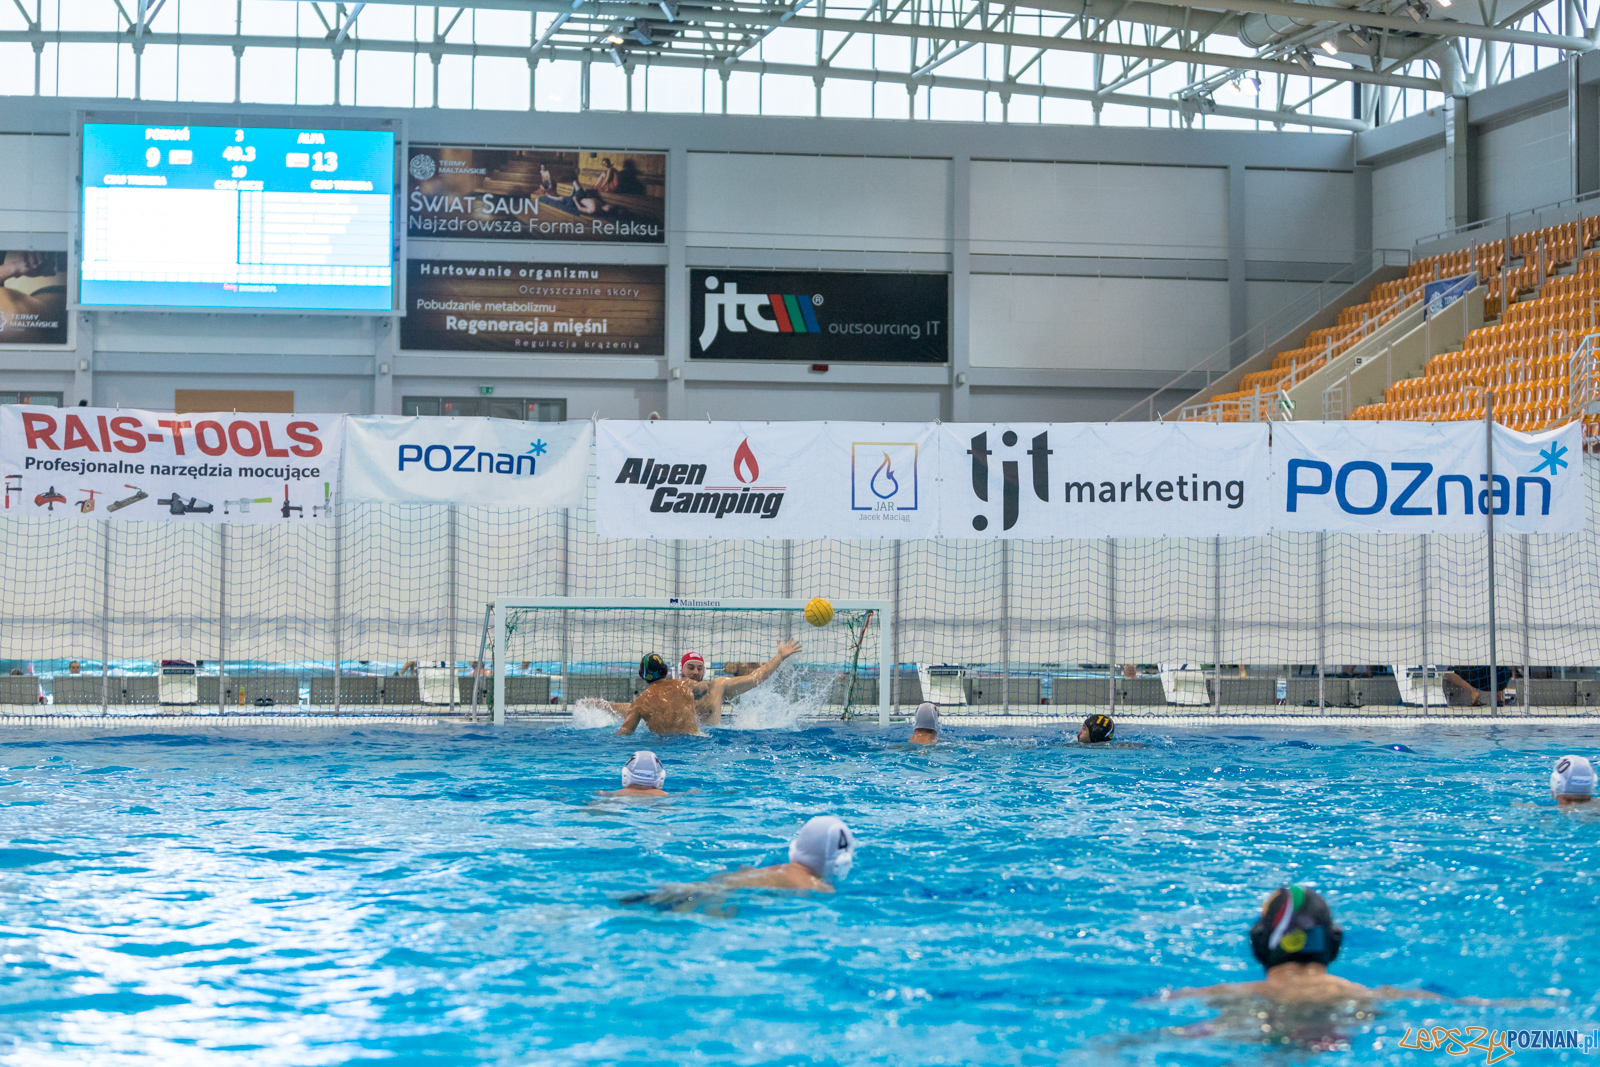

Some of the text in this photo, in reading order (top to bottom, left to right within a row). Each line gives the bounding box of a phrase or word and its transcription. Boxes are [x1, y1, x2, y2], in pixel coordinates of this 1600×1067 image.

[235, 129, 244, 142] 3
[297, 133, 325, 144] ALFA
[146, 146, 160, 168] 9
[312, 152, 338, 172] 13
[438, 166, 487, 174] MALTAŃSKIE
[409, 215, 658, 236] Najzdrowsza Forma Relaksu
[420, 264, 599, 280] Hartowanie organizmu
[519, 285, 640, 298] Oczyszczanie skóry
[416, 299, 556, 313] Pobudzanie metabolizmu
[446, 316, 608, 336] Regeneracja mięśni
[828, 320, 941, 340] outsourcing IT
[514, 338, 640, 350] Regulacja krążenia
[22, 412, 324, 458] RAIS-TOOLS
[25, 456, 320, 481] Profesjonalne narzędzia mocujące
[614, 458, 708, 490] Alpen
[1064, 473, 1244, 510] marketing
[650, 486, 785, 519] Camping
[874, 502, 894, 512] JAR
[882, 514, 910, 522] Maciąg
[680, 599, 720, 607] Malmsten
[1096, 715, 1110, 728] 11
[838, 828, 849, 852] 4
